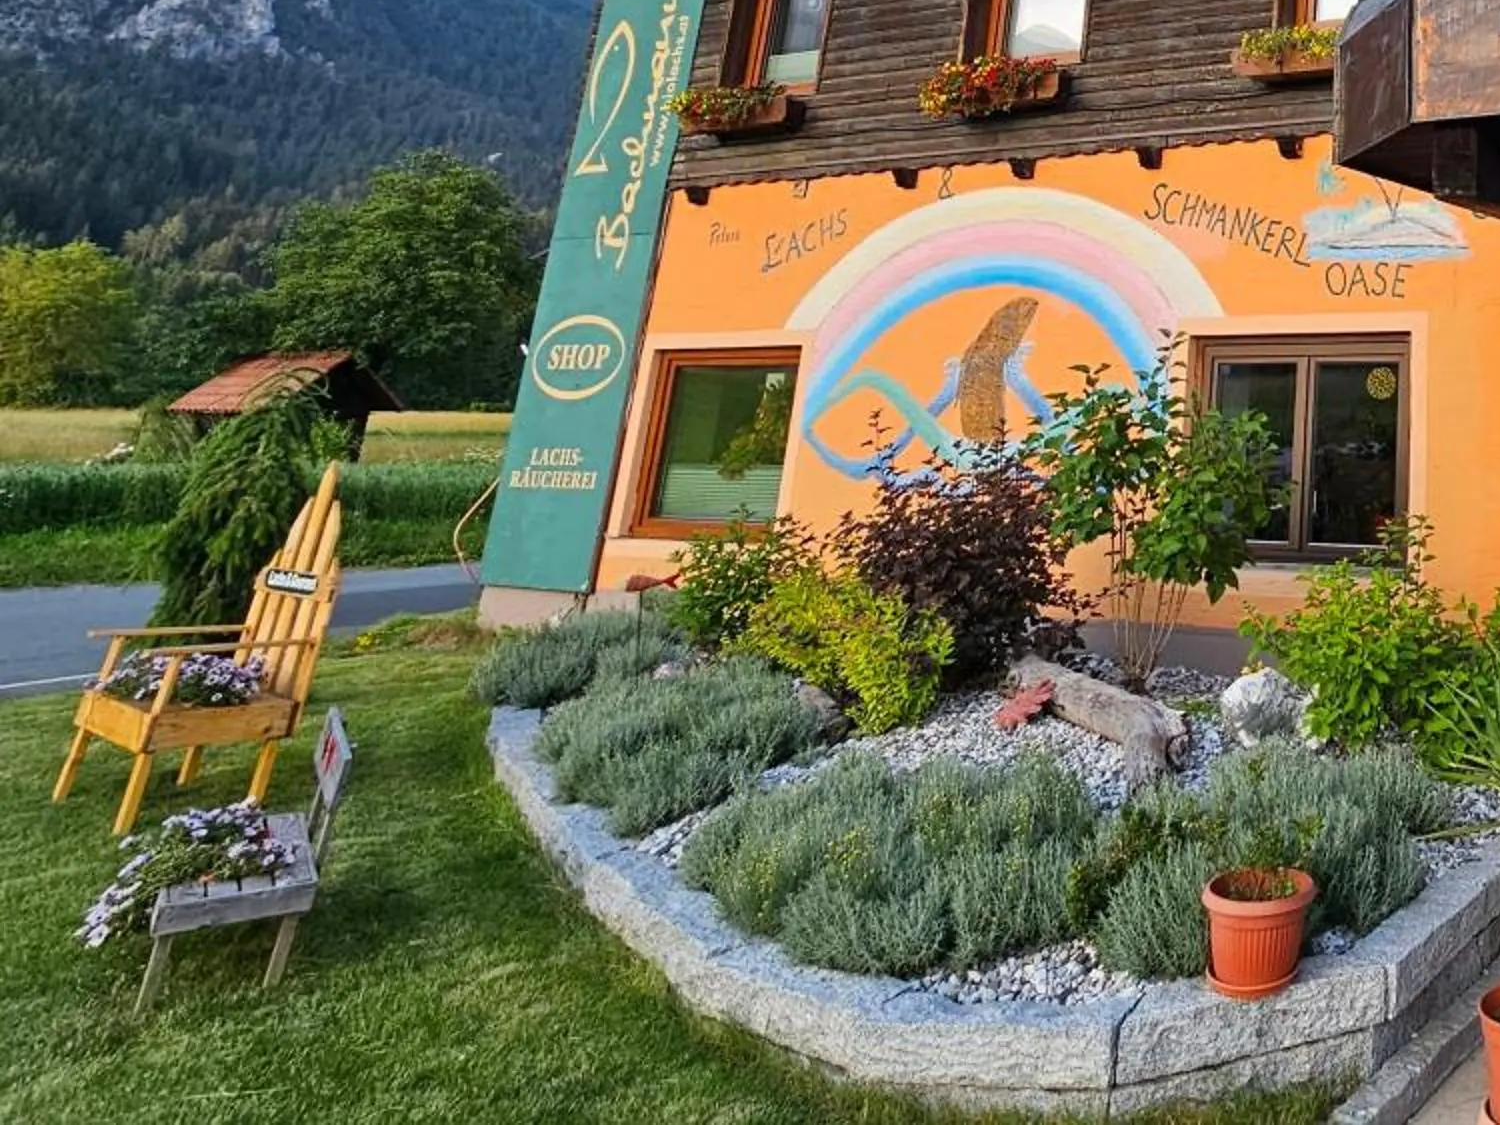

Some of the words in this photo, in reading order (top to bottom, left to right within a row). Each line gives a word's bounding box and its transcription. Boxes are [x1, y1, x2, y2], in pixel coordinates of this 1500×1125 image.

[761, 208, 849, 272] LACHS
[1144, 182, 1311, 268] SCHMANKERL
[1325, 262, 1414, 298] OASE
[547, 344, 611, 371] SHOP
[530, 446, 585, 467] LACHS-
[510, 466, 598, 490] RÄUCHEREI
